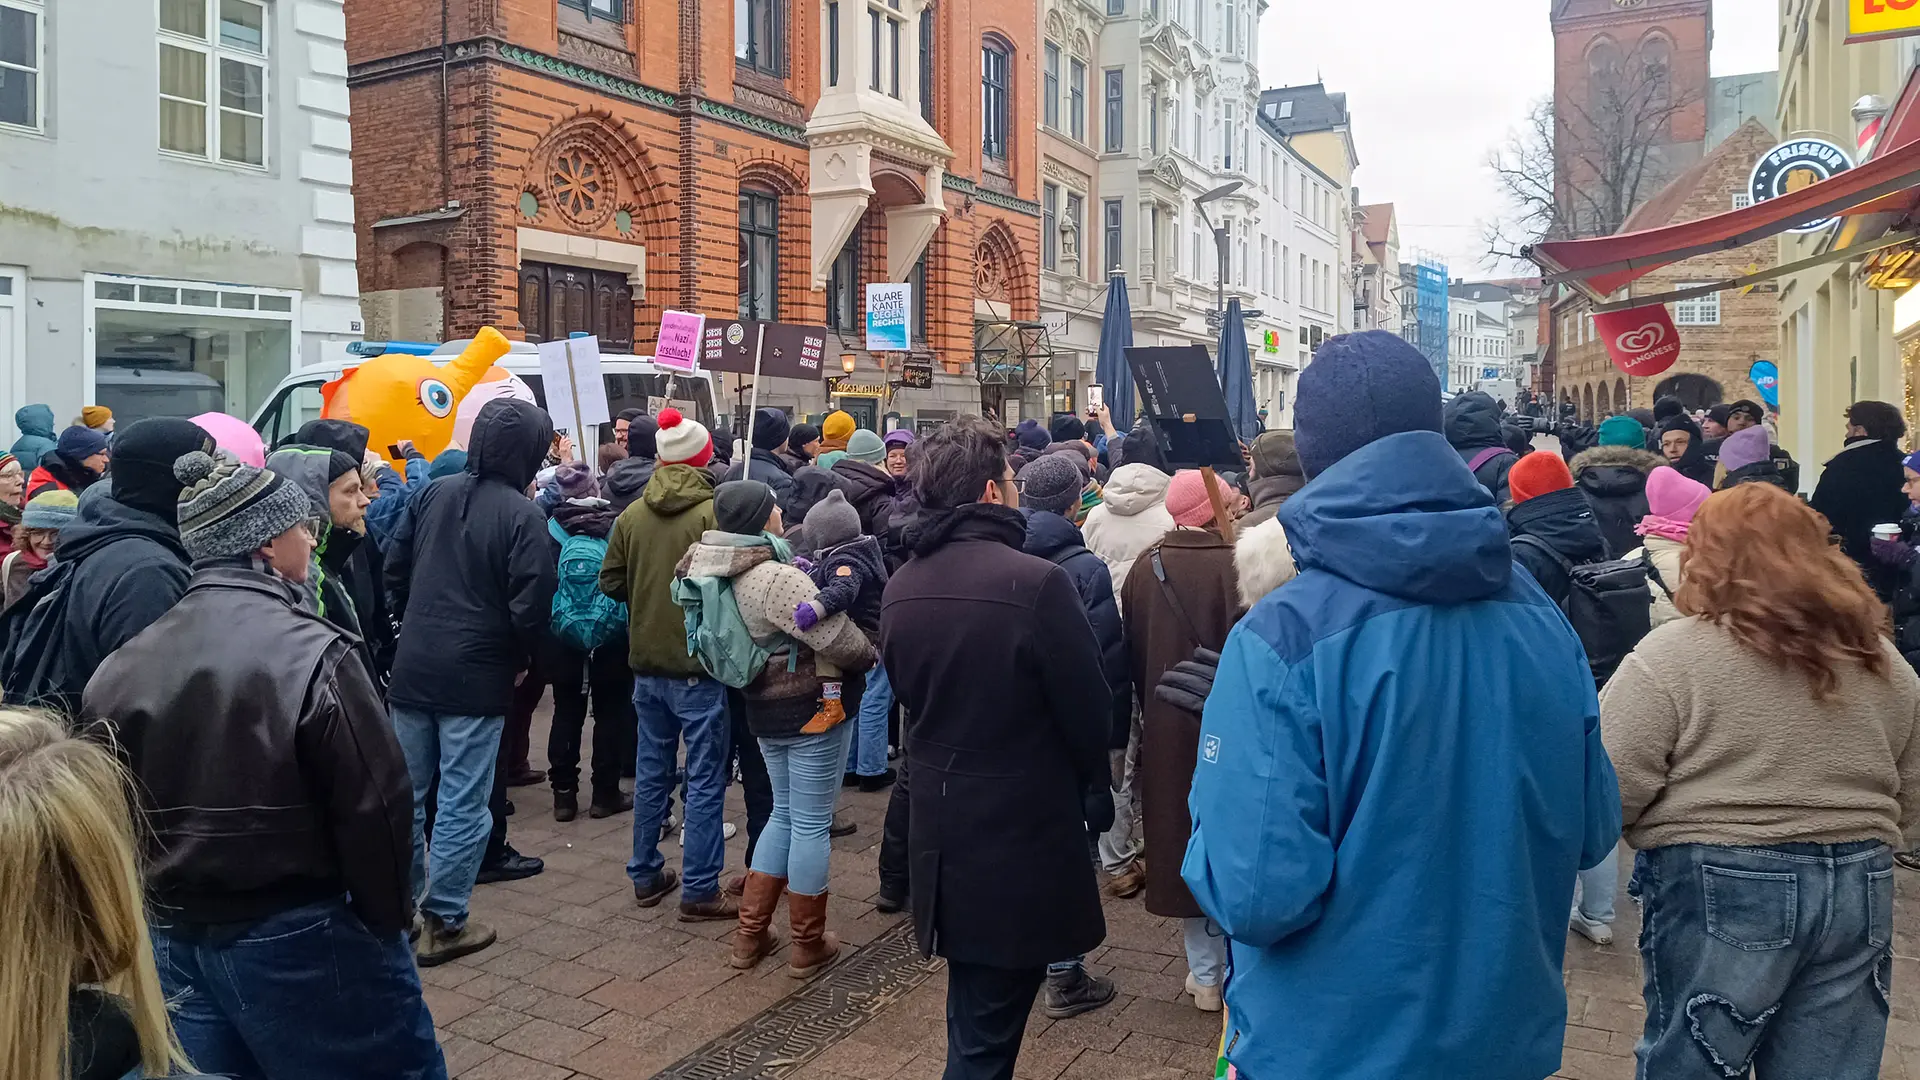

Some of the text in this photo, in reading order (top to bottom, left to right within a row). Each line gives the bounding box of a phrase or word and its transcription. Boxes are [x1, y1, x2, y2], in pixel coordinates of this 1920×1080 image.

[1768, 143, 1843, 169] FRISEUR
[872, 291, 903, 302] KLARE
[872, 300, 904, 311] KANTE
[872, 309, 904, 320] GEGEN
[872, 318, 904, 328] RECHTS
[674, 333, 690, 344] Nazi
[1624, 344, 1675, 368] LANGNESE
